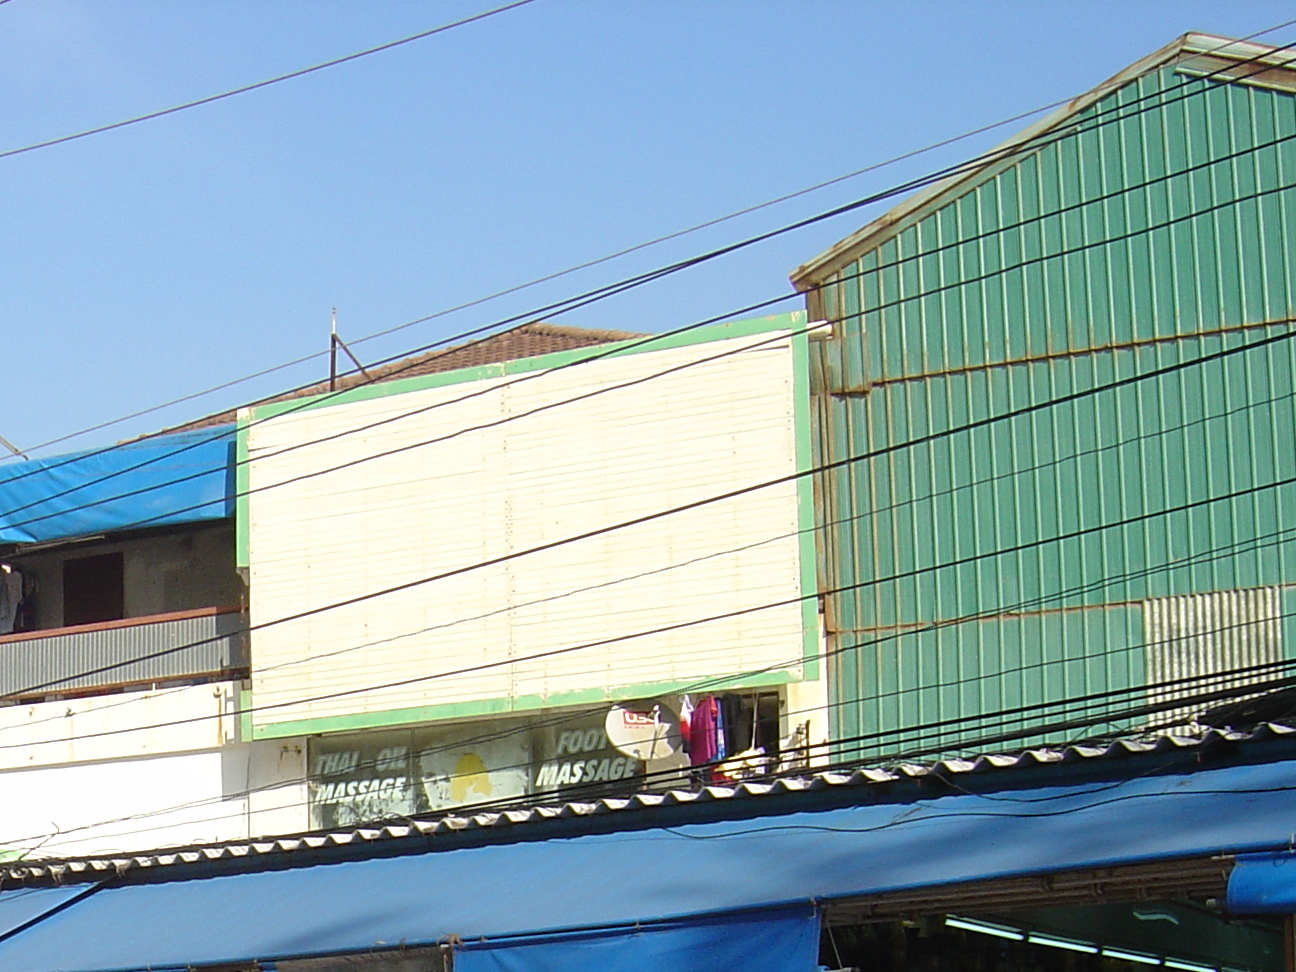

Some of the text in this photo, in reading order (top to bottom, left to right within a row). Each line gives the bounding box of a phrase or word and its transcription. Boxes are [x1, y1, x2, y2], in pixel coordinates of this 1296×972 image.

[558, 728, 605, 754] FOOT
[315, 751, 359, 775] THAI
[375, 746, 408, 771] OIL
[536, 757, 636, 786] MASSAGE
[315, 777, 407, 805] MASSAGE
